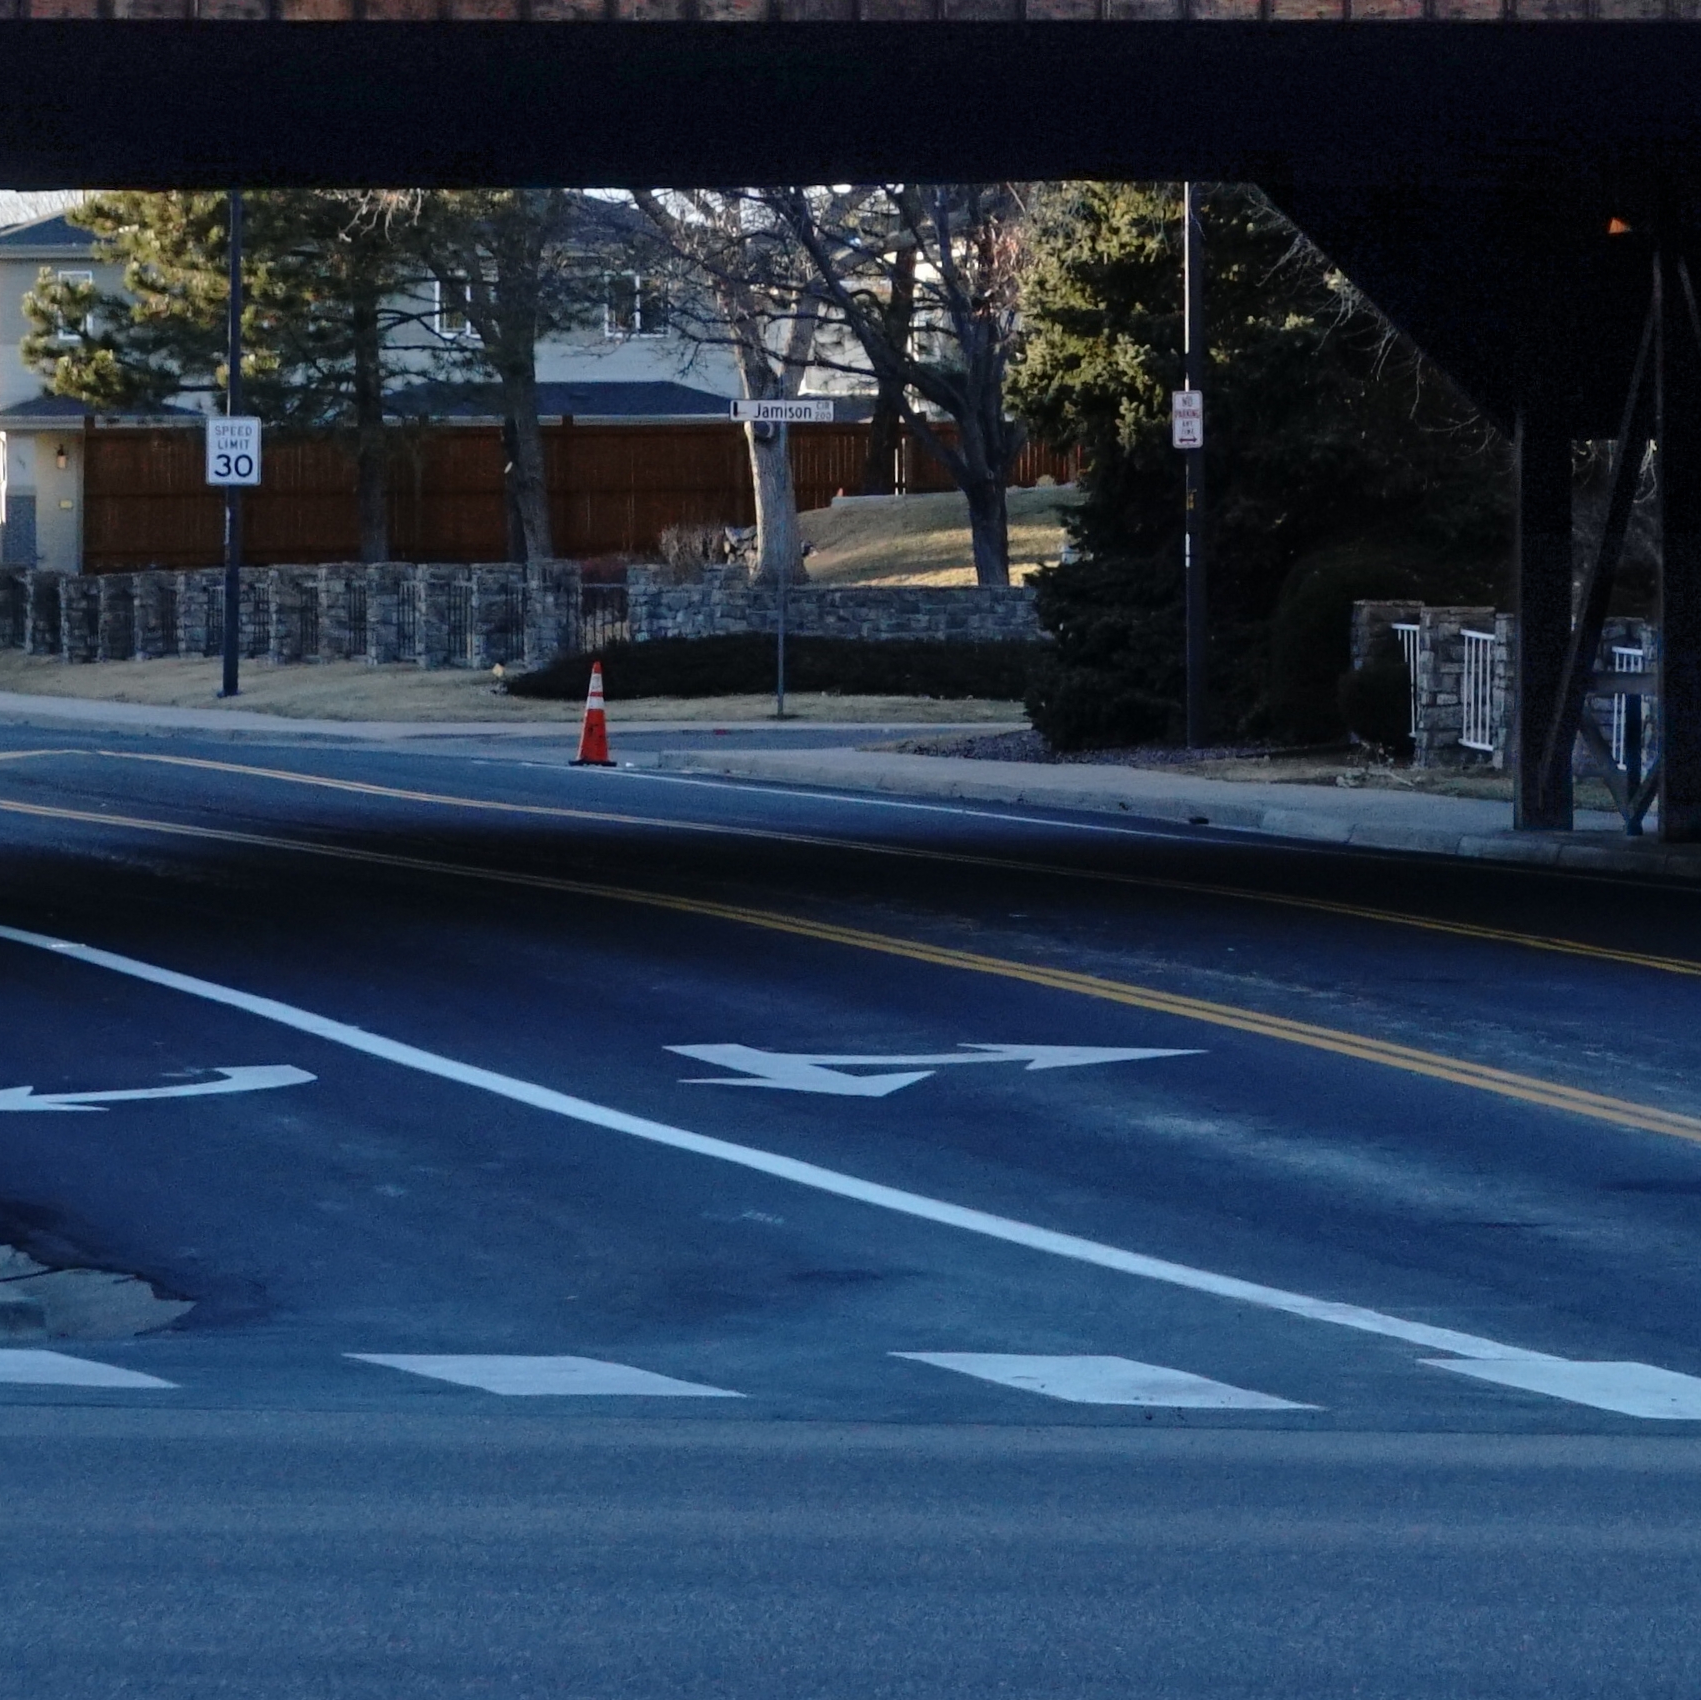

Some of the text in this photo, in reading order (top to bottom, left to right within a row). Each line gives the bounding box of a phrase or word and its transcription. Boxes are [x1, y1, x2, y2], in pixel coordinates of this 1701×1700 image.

[816, 401, 830, 410] CIR
[1182, 396, 1194, 407] NO
[754, 402, 812, 419] Jamison
[215, 425, 253, 437] SPEED
[217, 439, 250, 450] LIMIT
[214, 454, 254, 478] 30
